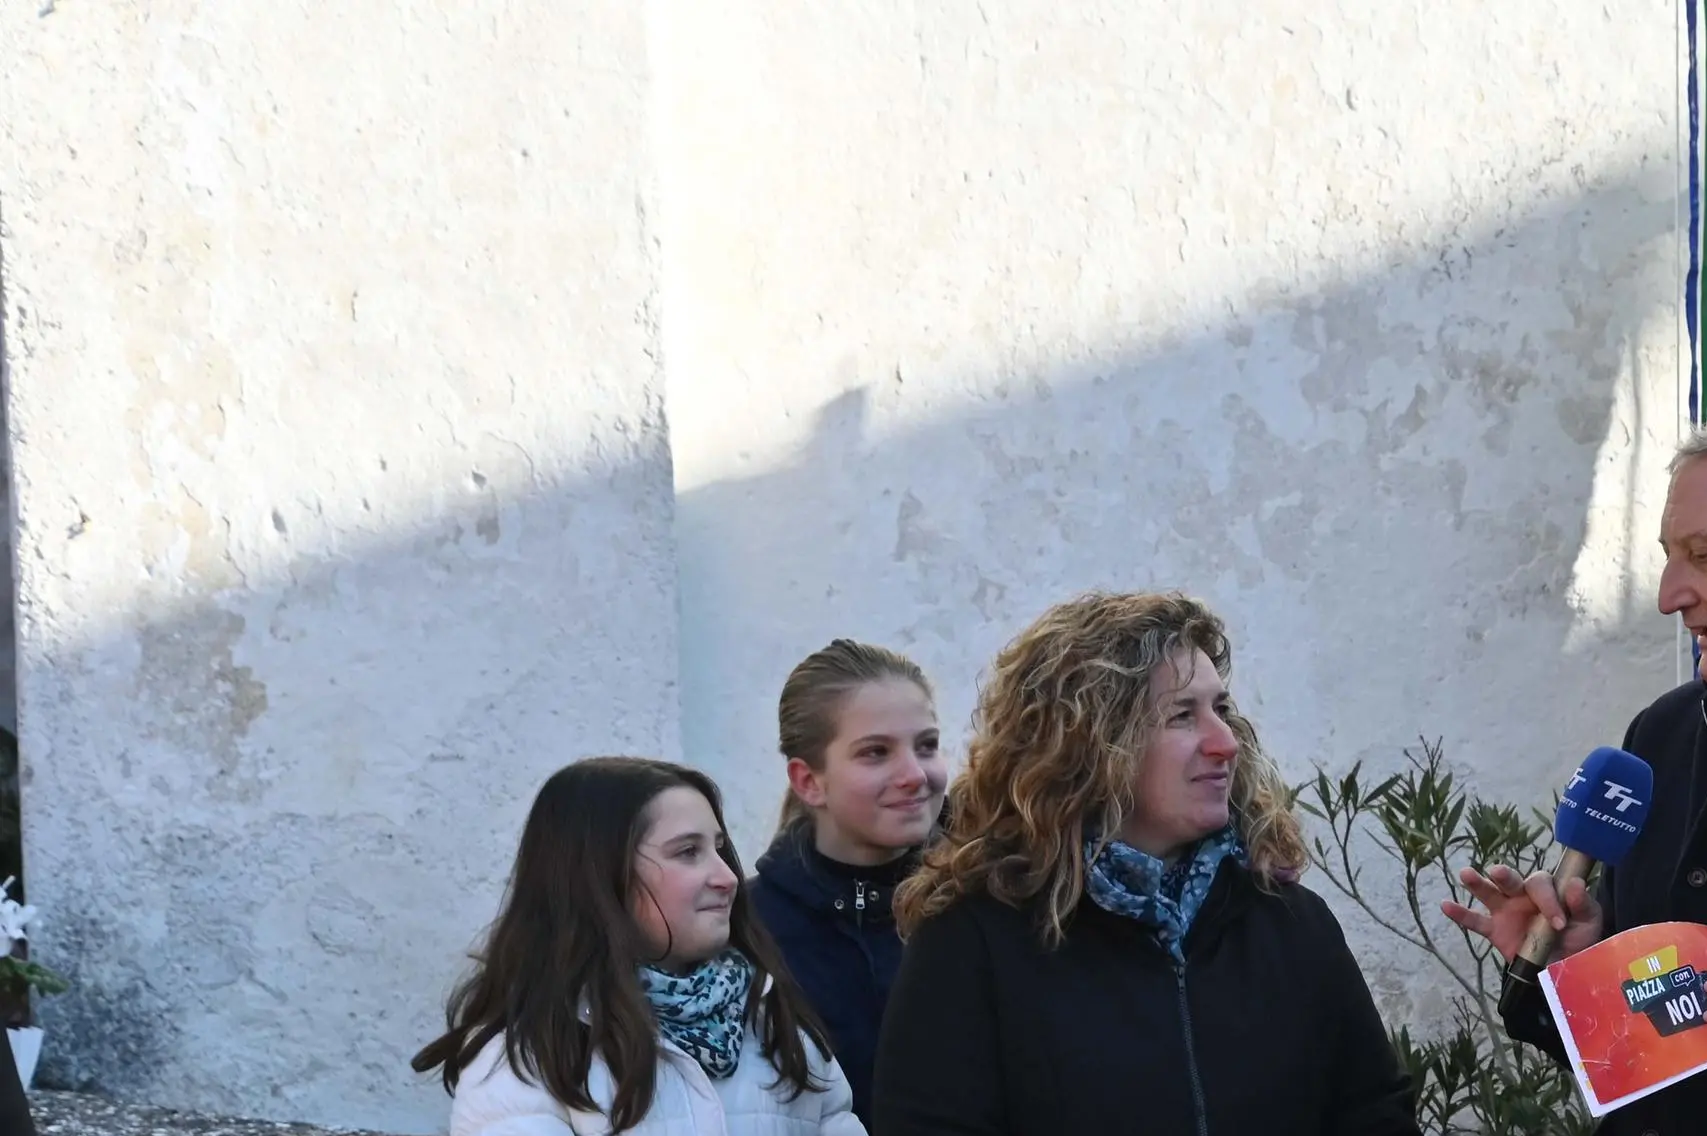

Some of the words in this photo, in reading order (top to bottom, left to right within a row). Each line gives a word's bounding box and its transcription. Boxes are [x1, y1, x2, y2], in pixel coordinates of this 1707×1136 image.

[1584, 806, 1637, 833] TELETUTTO
[1646, 955, 1662, 974] IN
[1625, 977, 1666, 1006] PIAZZA
[1674, 971, 1691, 983] con
[1664, 991, 1703, 1027] NOI
